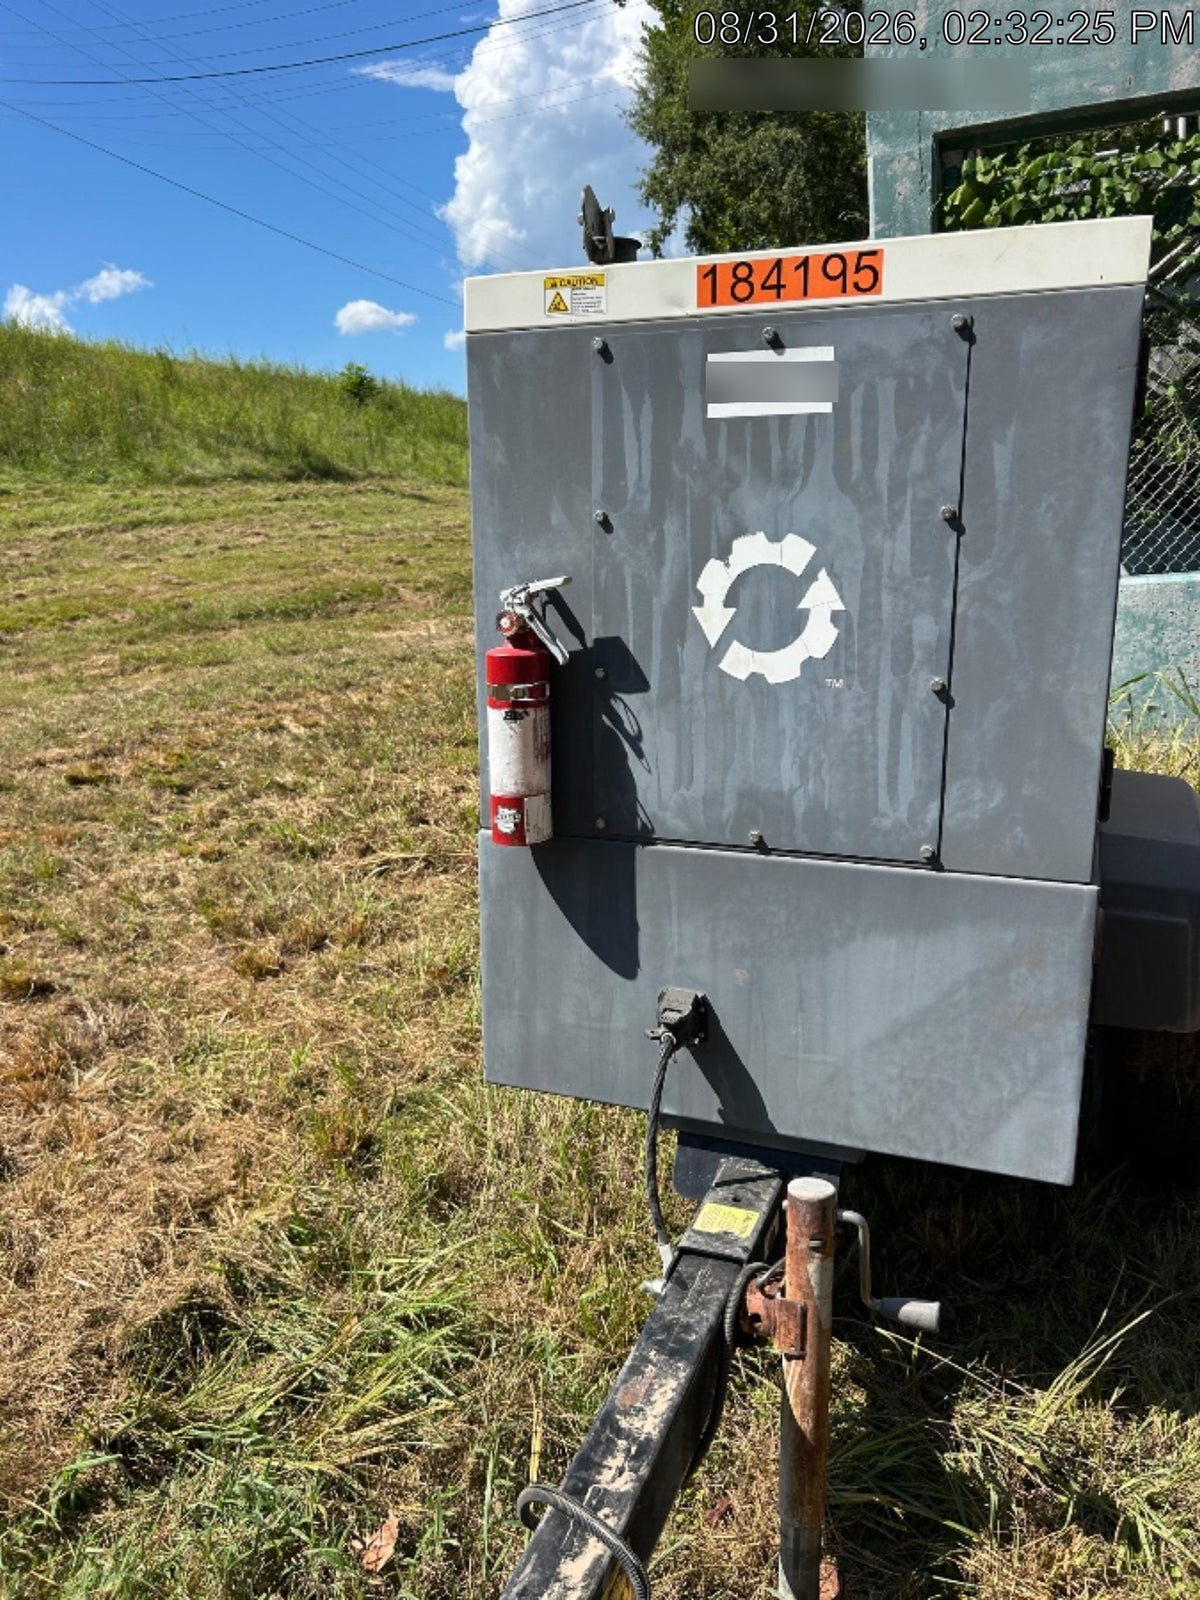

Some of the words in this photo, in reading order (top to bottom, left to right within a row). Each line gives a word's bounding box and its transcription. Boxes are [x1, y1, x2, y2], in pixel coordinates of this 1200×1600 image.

[560, 276, 598, 287] CAUTION
[702, 250, 879, 304] 184195
[825, 678, 844, 689] TM
